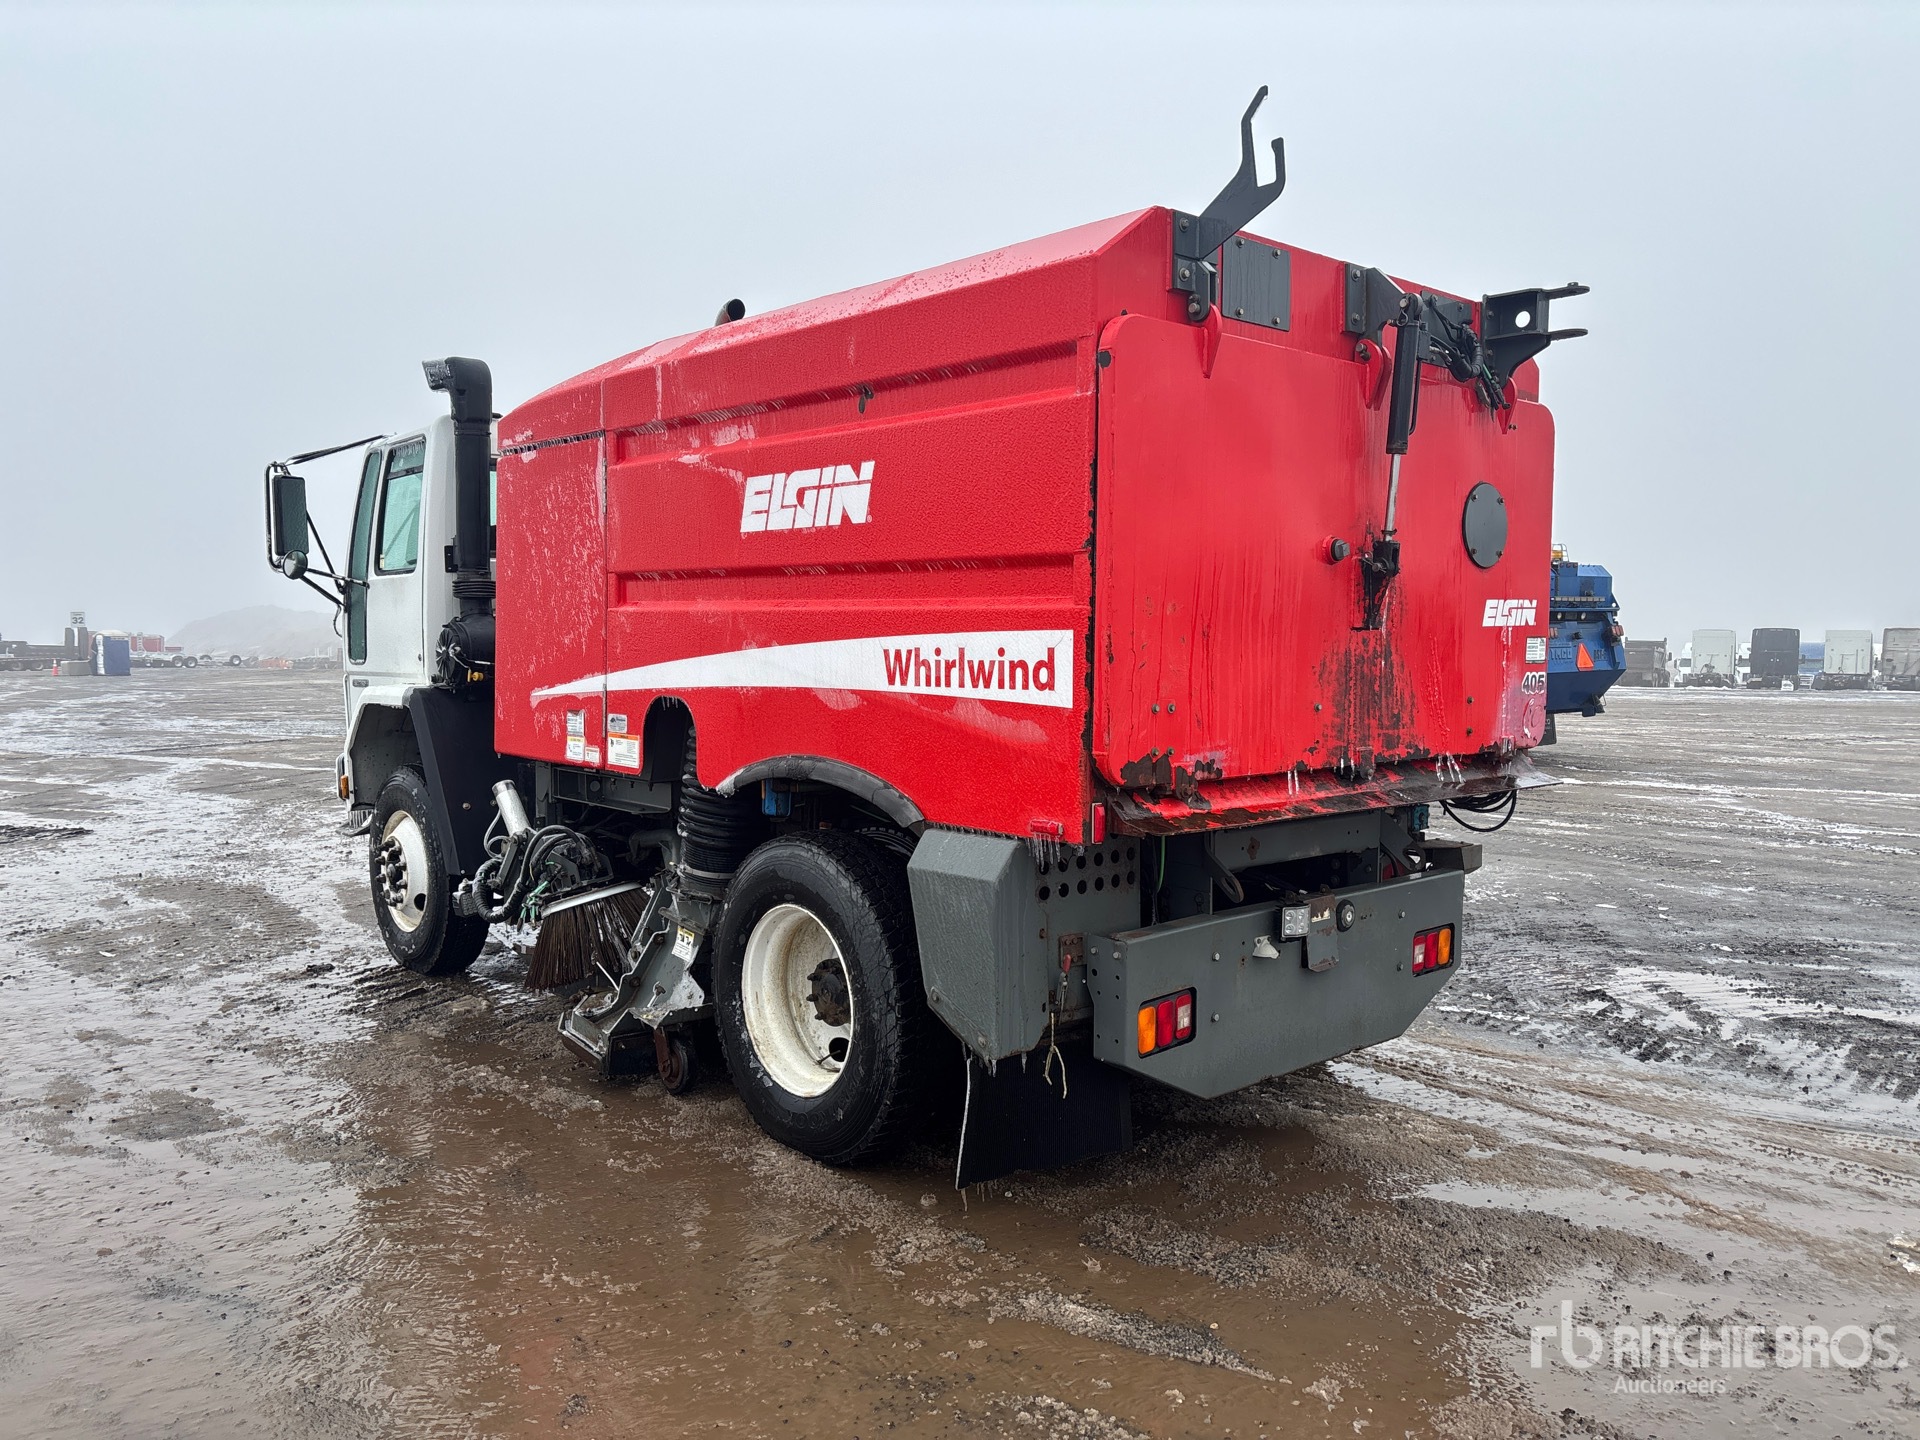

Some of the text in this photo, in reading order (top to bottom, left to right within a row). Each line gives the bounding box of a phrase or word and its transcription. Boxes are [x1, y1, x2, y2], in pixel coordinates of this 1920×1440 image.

[740, 461, 875, 532] ELGIN
[72, 616, 84, 624] 32
[1482, 599, 1537, 627] ELGIN
[883, 646, 1056, 691] Whirlwind
[1522, 673, 1545, 693] 405
